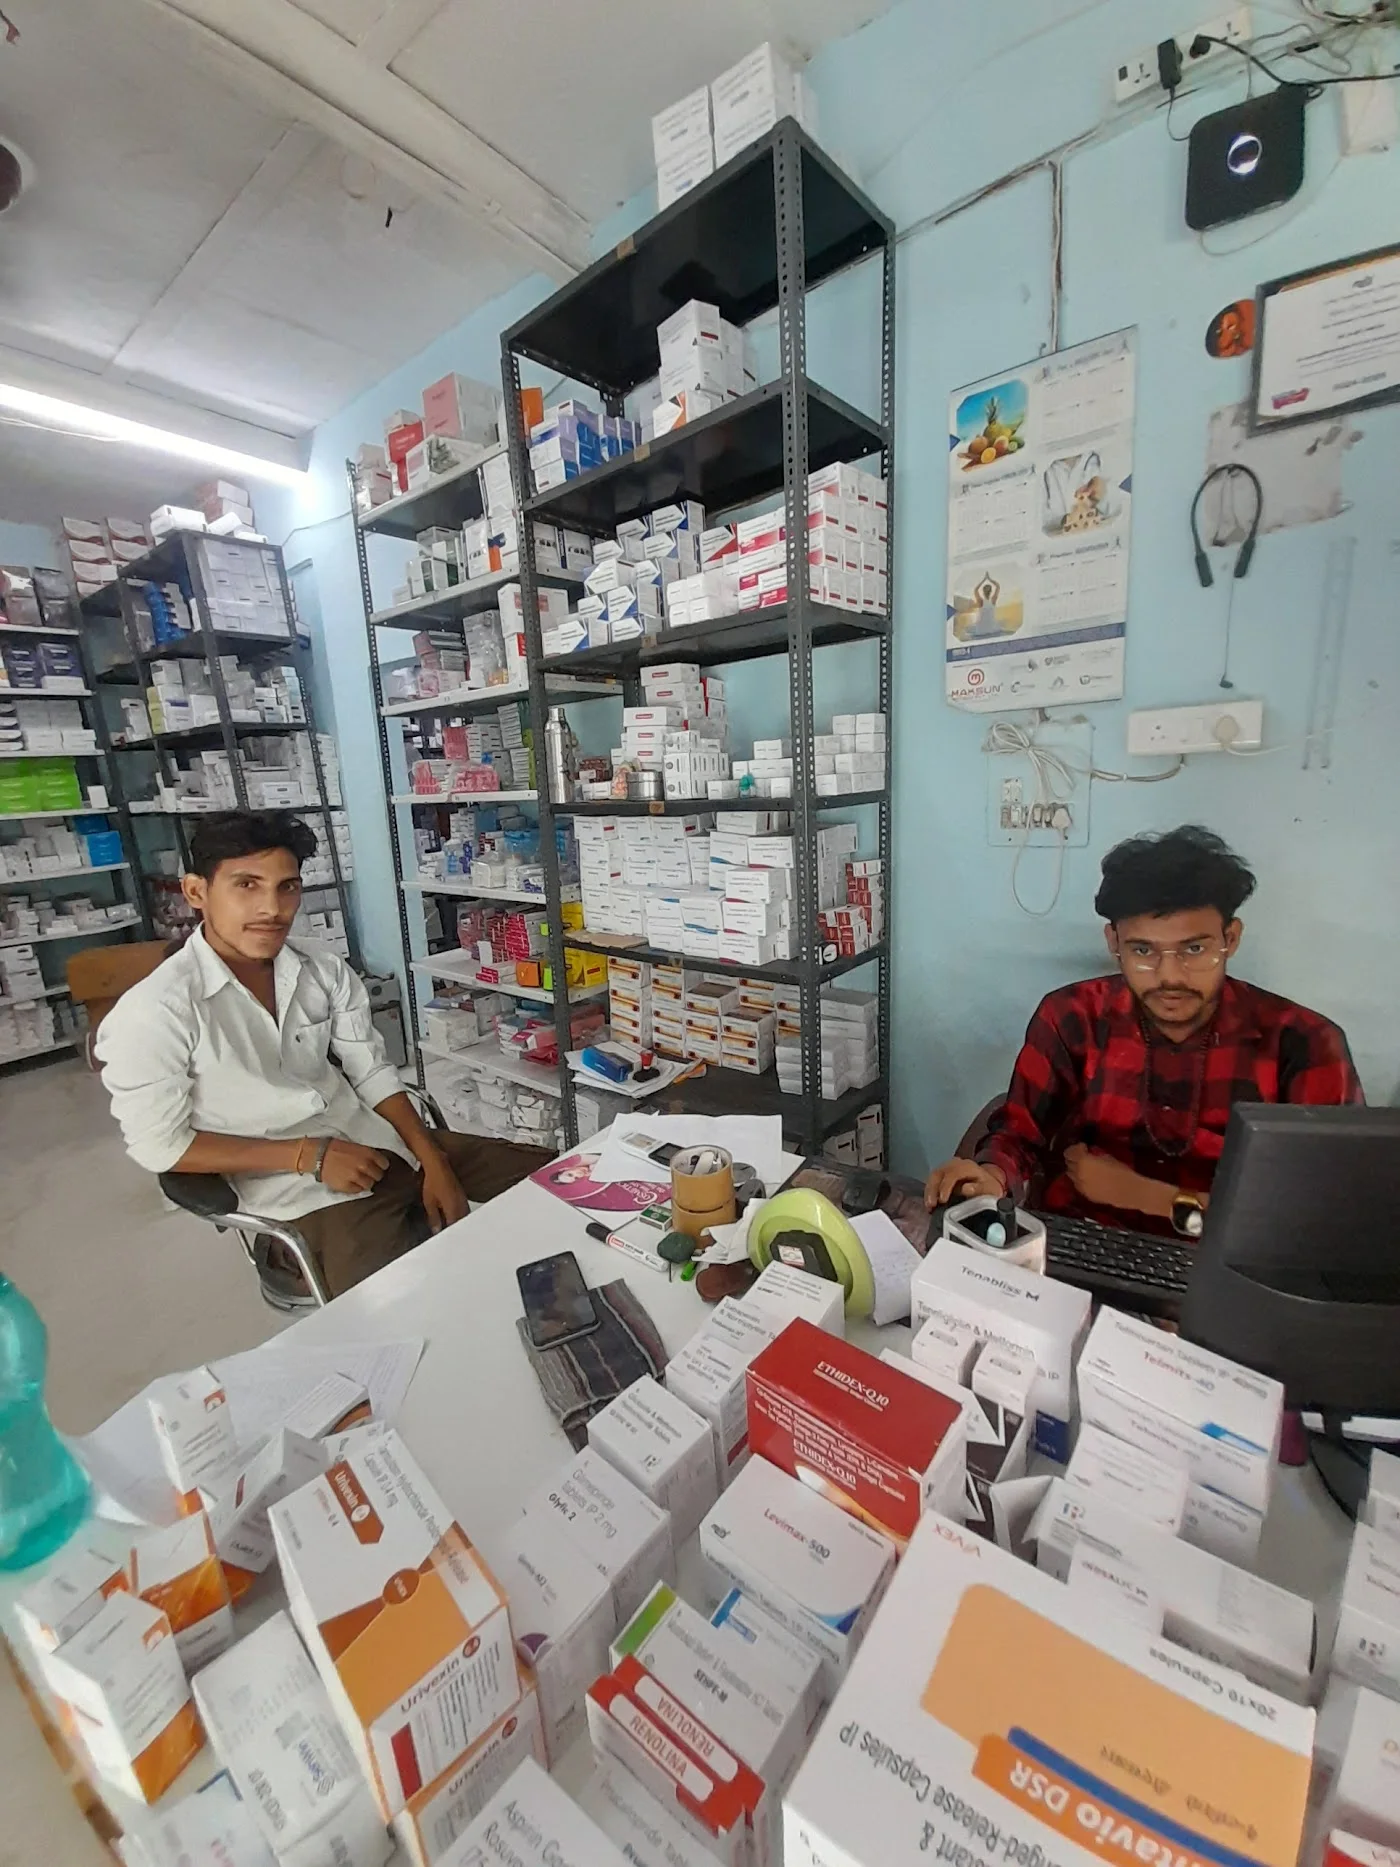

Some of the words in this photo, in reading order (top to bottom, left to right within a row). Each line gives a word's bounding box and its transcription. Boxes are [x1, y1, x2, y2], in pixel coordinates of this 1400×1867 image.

[951, 685, 1001, 699] MAKSUN
[961, 1265, 1022, 1296] Tenabliss
[1026, 1290, 1040, 1302] M
[816, 1361, 890, 1408] ETHIDEX-Q10
[793, 1438, 857, 1486] ETHIDEX-Q10
[568, 1511, 577, 1522] 2
[1149, 1646, 1224, 1695] Capsules
[628, 1715, 689, 1778] RENOLINA
[657, 1696, 716, 1758] RENOLINA
[839, 1720, 860, 1748] IP
[860, 1729, 932, 1803] Capsules
[1009, 1759, 1071, 1815] DSR
[918, 1820, 935, 1852] &
